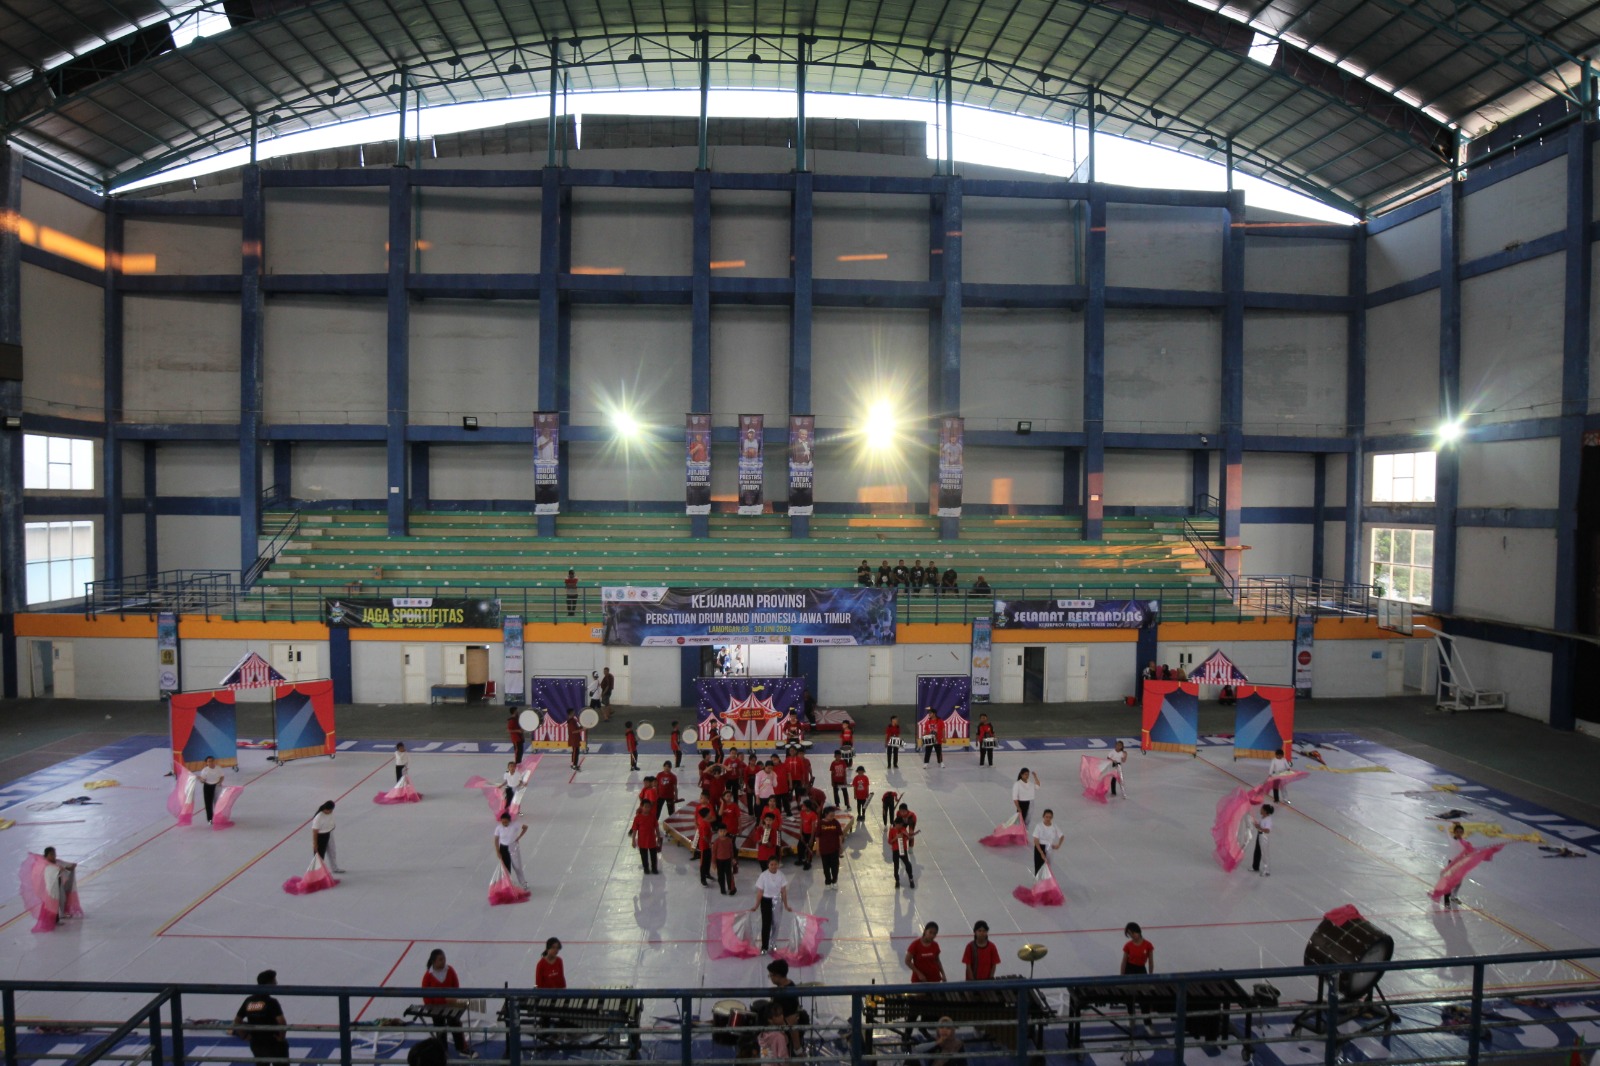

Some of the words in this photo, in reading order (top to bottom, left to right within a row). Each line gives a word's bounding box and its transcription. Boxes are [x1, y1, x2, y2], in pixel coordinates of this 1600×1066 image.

[691, 594, 754, 609] KEJUARAAN
[756, 594, 806, 609] PROVINSI
[362, 607, 390, 623] JAGA
[392, 608, 465, 623] SPORTIFITAS
[645, 613, 697, 625] PERSATUAN
[699, 613, 724, 624] DRUM
[725, 613, 750, 624] BAND
[751, 612, 797, 624] INDONESIA
[799, 612, 822, 624] JAWA
[823, 612, 852, 624] TIMUR
[1013, 611, 1065, 623] SELAMAT
[1067, 611, 1143, 622] BERTANDING
[753, 625, 762, 633] 30
[762, 625, 775, 633] JUNI
[776, 625, 792, 633] 2024
